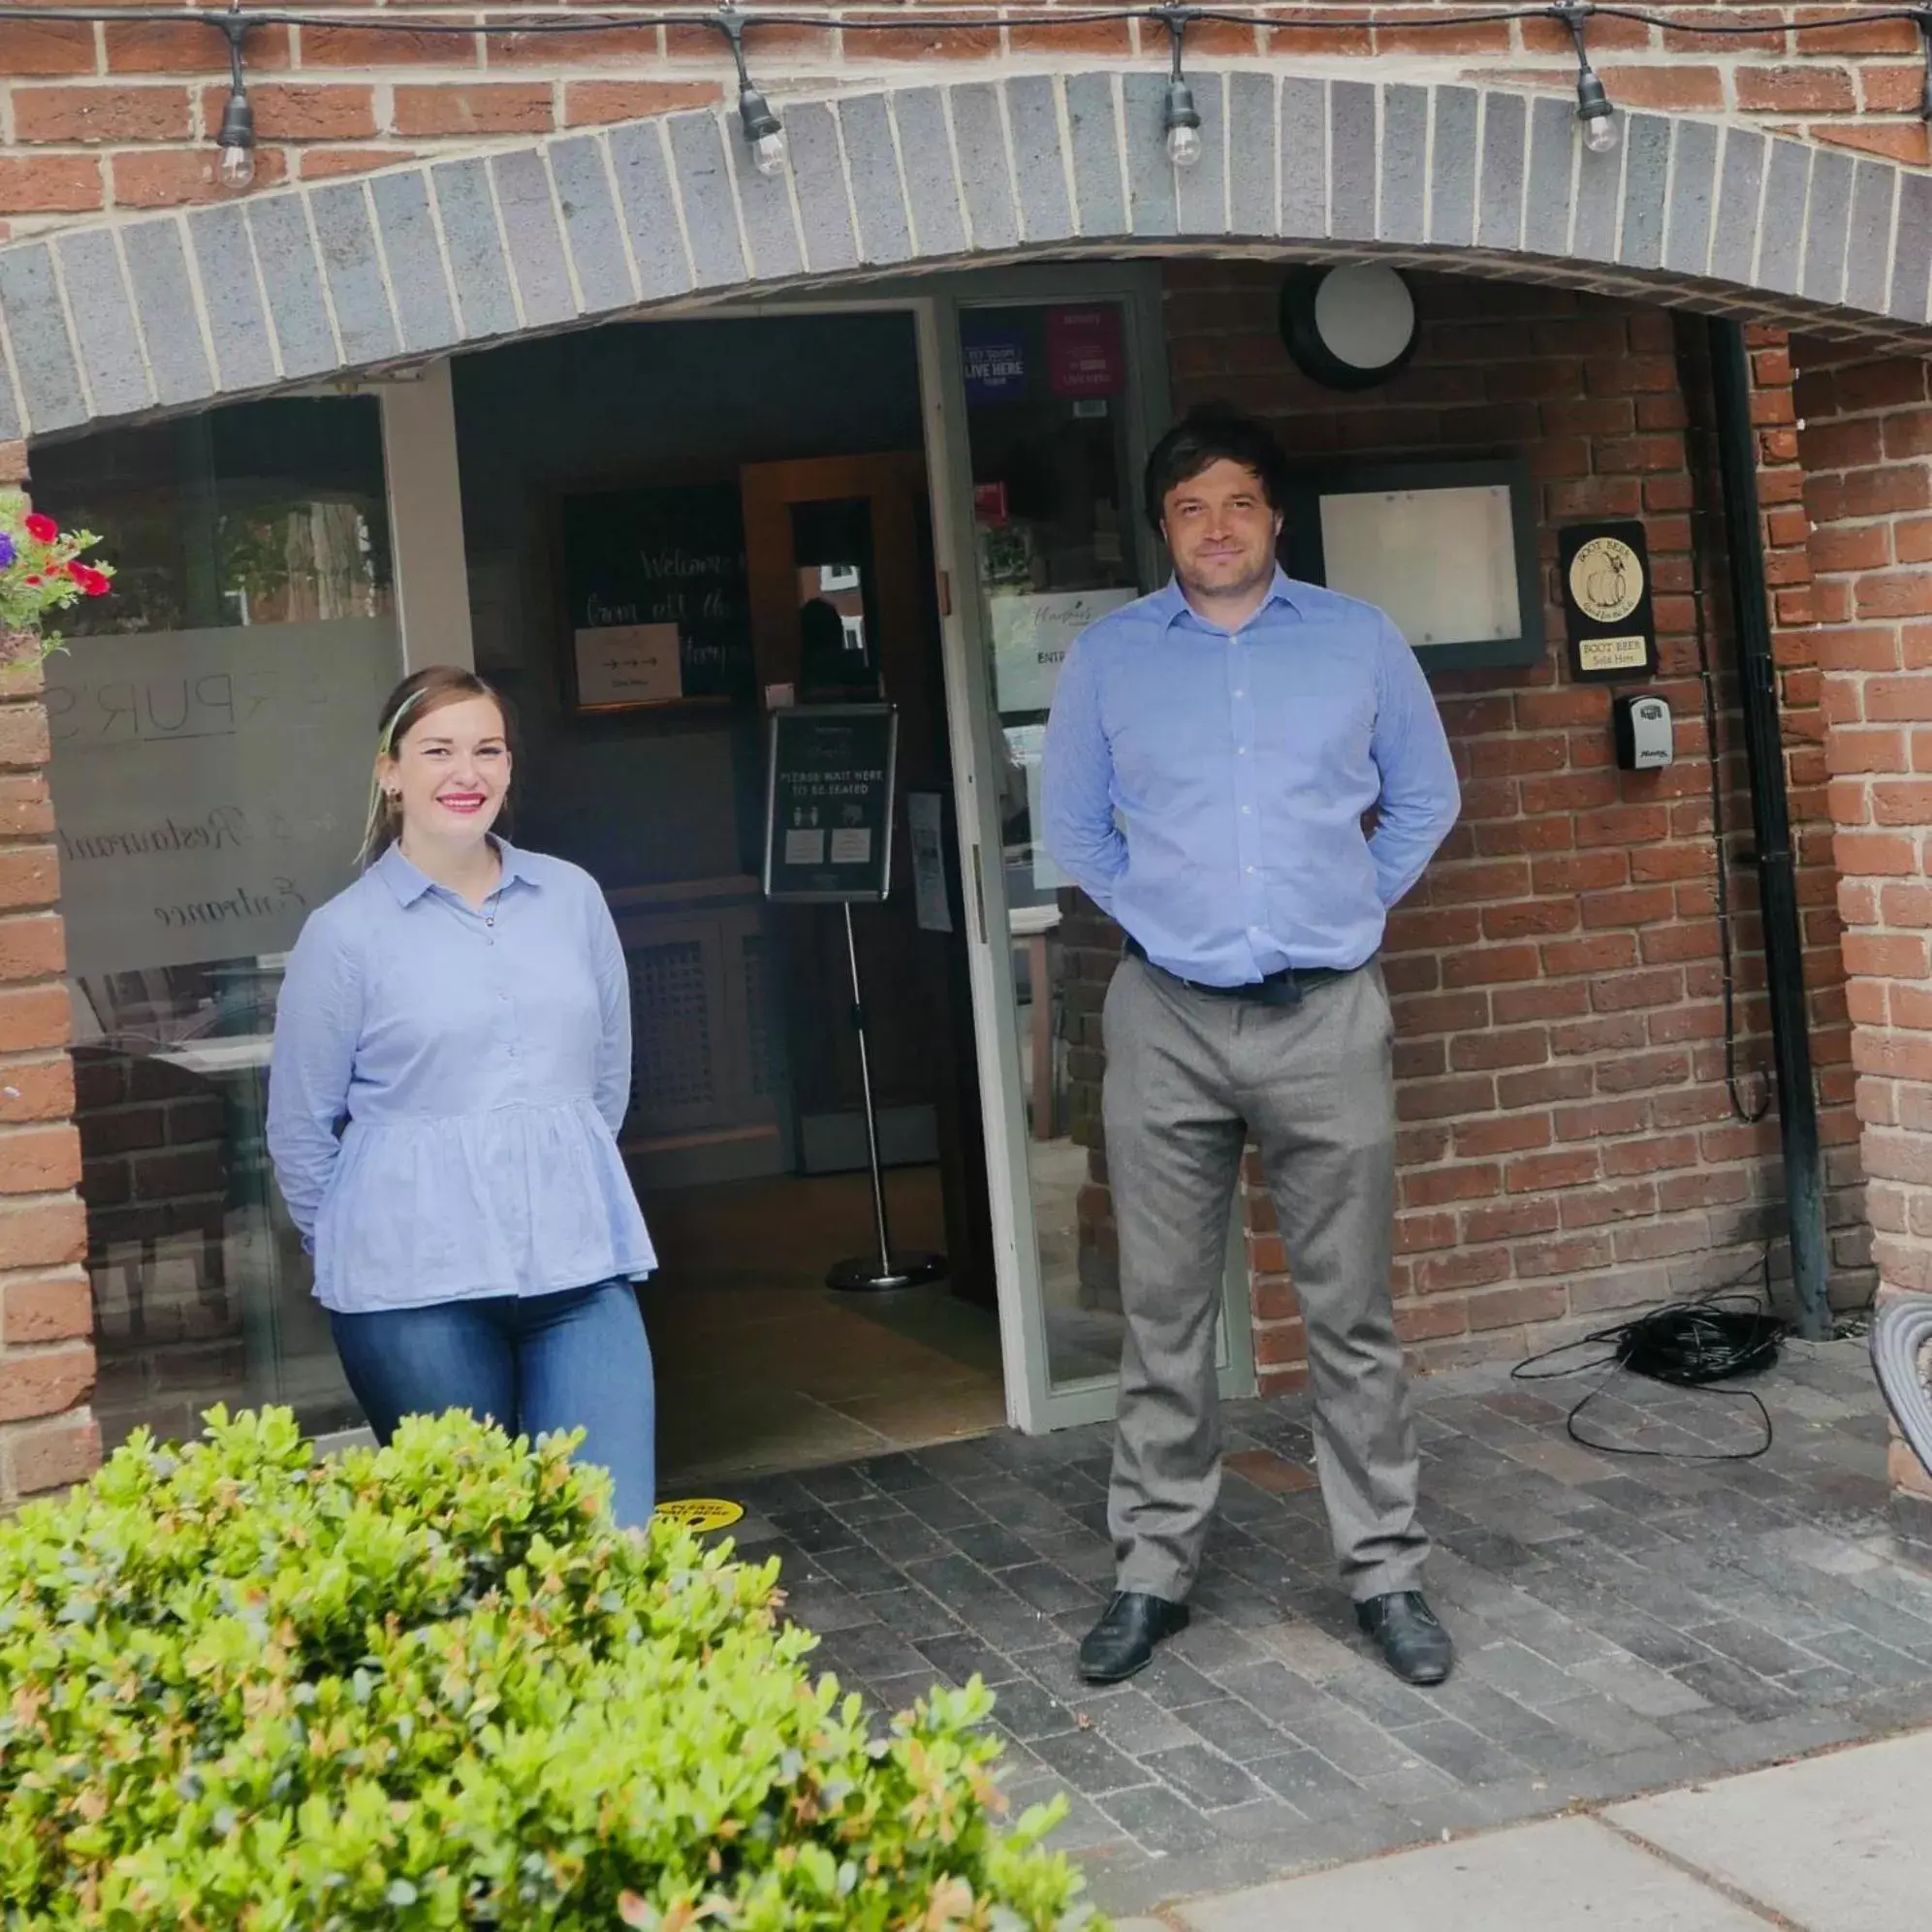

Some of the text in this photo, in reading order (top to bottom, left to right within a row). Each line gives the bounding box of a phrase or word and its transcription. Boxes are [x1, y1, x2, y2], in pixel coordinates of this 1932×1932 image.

[965, 362, 1025, 378] LIVE HERE
[1037, 650, 1066, 664] ENTR
[780, 769, 884, 783] PLEASE WAIT HERE
[792, 784, 808, 796] TO
